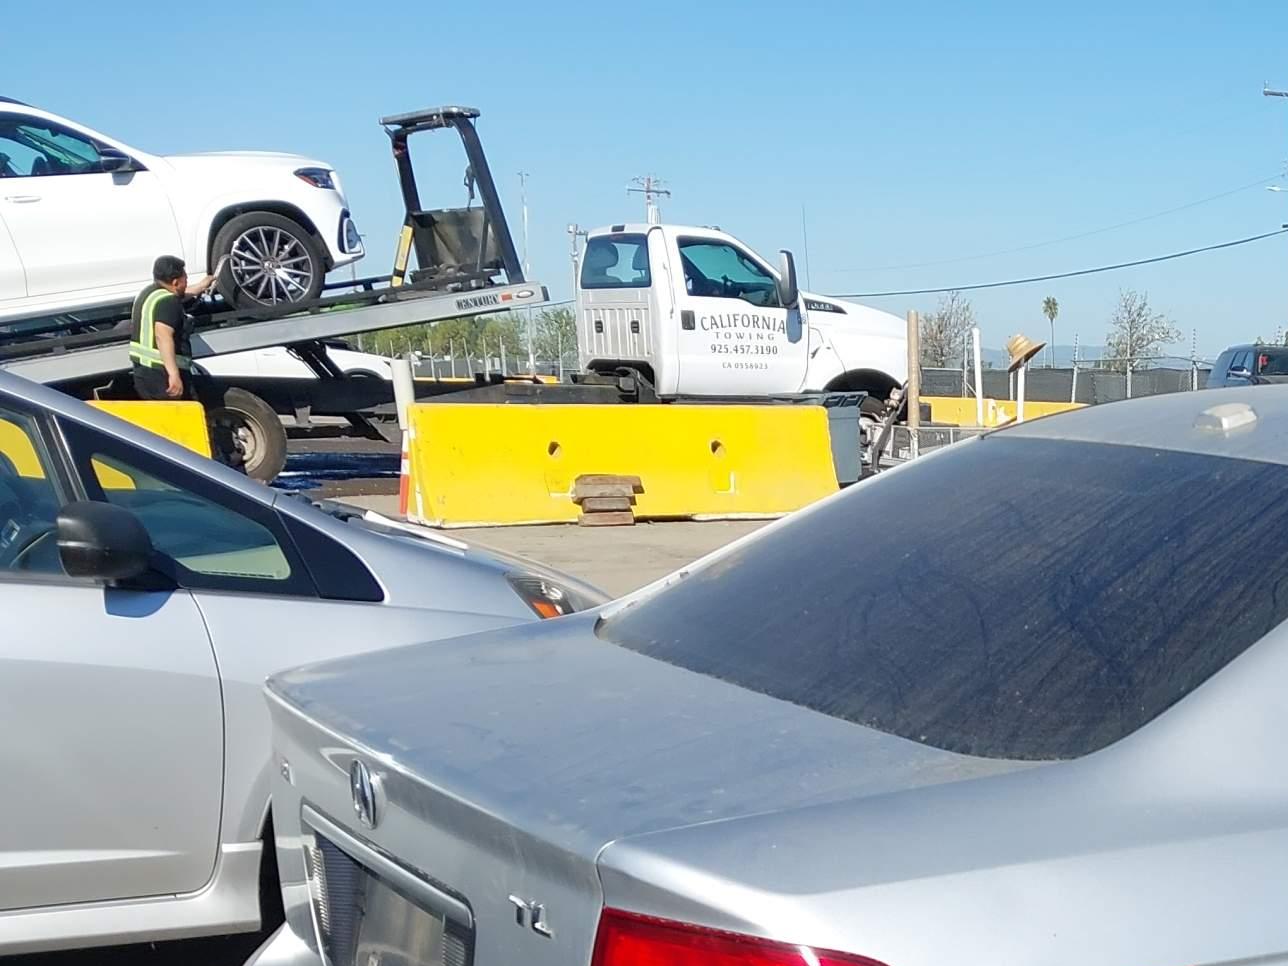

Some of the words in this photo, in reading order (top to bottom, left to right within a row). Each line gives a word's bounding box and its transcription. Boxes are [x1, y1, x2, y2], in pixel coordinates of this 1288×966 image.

[700, 313, 785, 335] CALIFORNIA
[713, 331, 775, 341] TOWING
[710, 343, 778, 355] 925.457.3190
[722, 361, 732, 370] CA
[508, 894, 552, 939] TL
